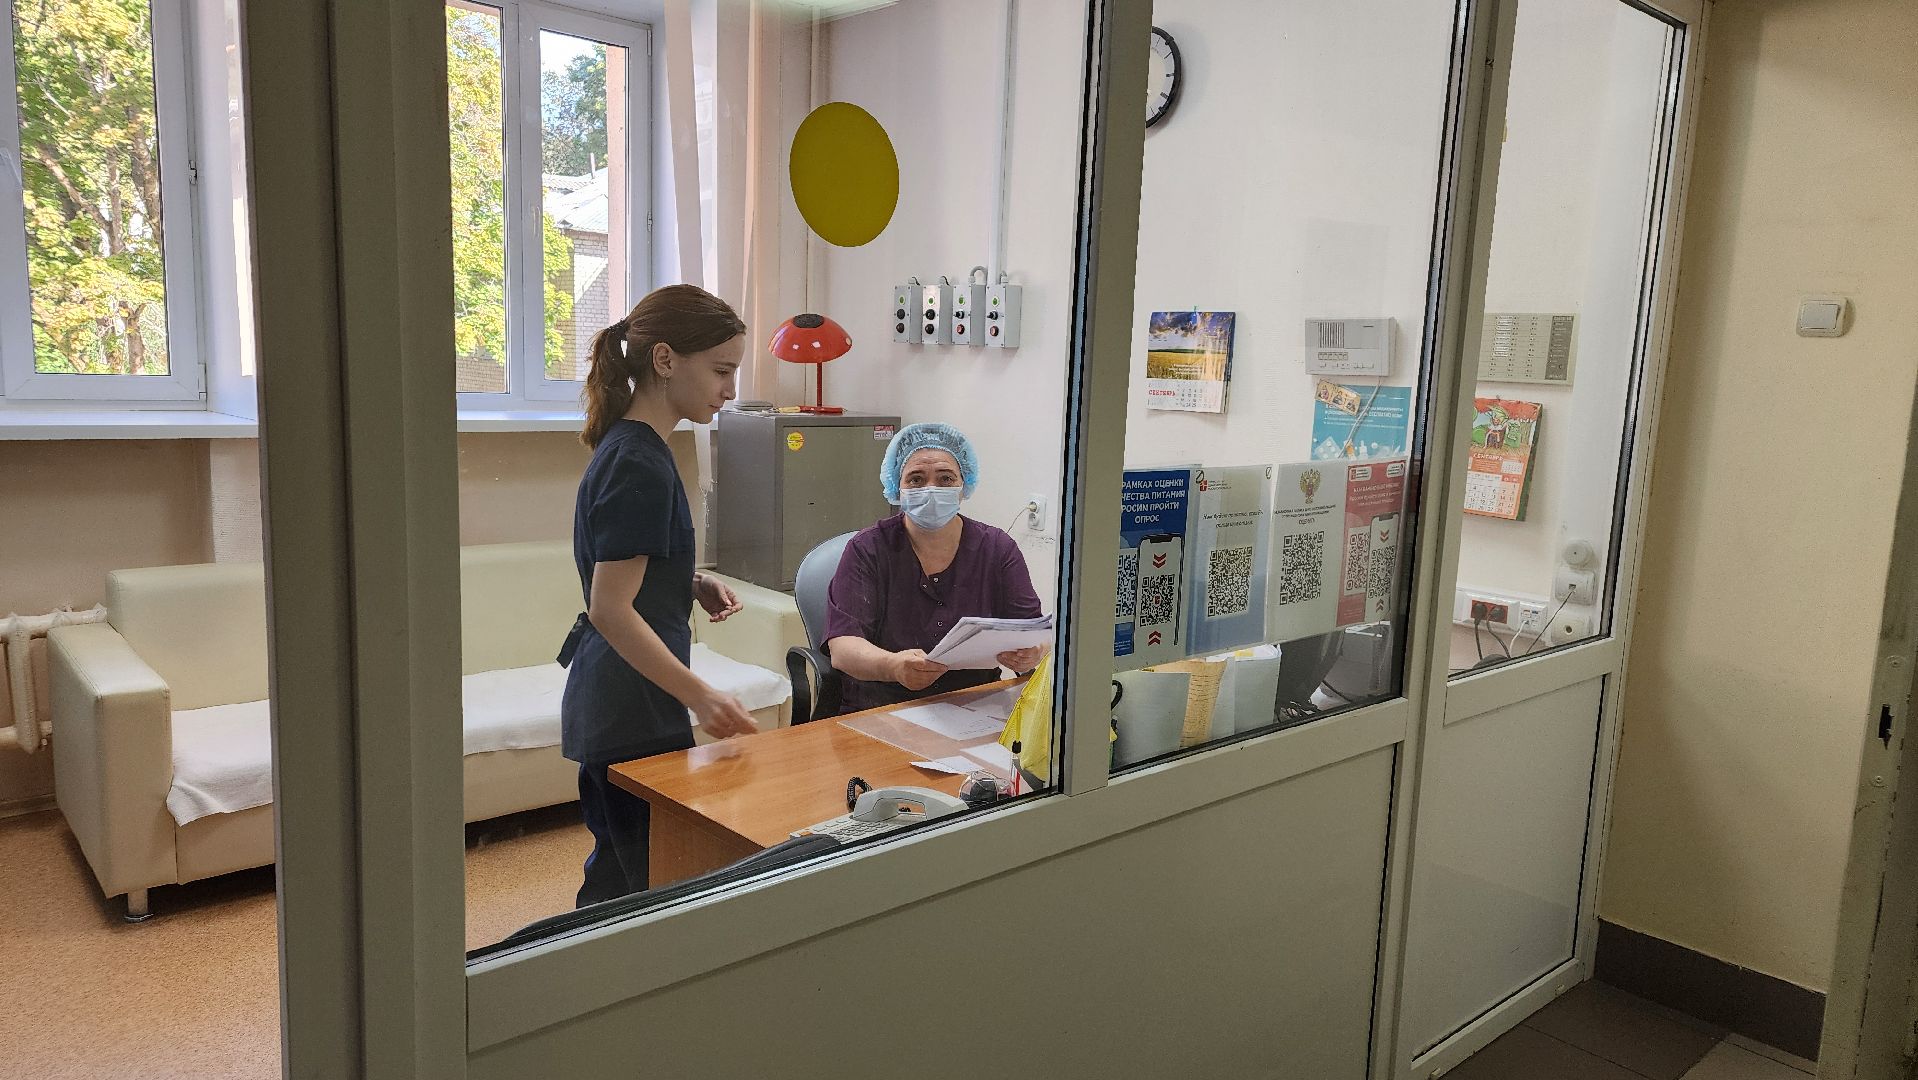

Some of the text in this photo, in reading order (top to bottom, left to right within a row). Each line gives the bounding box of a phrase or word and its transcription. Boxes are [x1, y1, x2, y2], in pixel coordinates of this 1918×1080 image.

[1122, 478, 1184, 490] РАМКАХ ОЦЕНКИ
[1151, 490, 1186, 500] ПИТАНИЯ
[1149, 500, 1180, 511] ПРОЙТИ
[1134, 514, 1160, 524] ОПРОС
